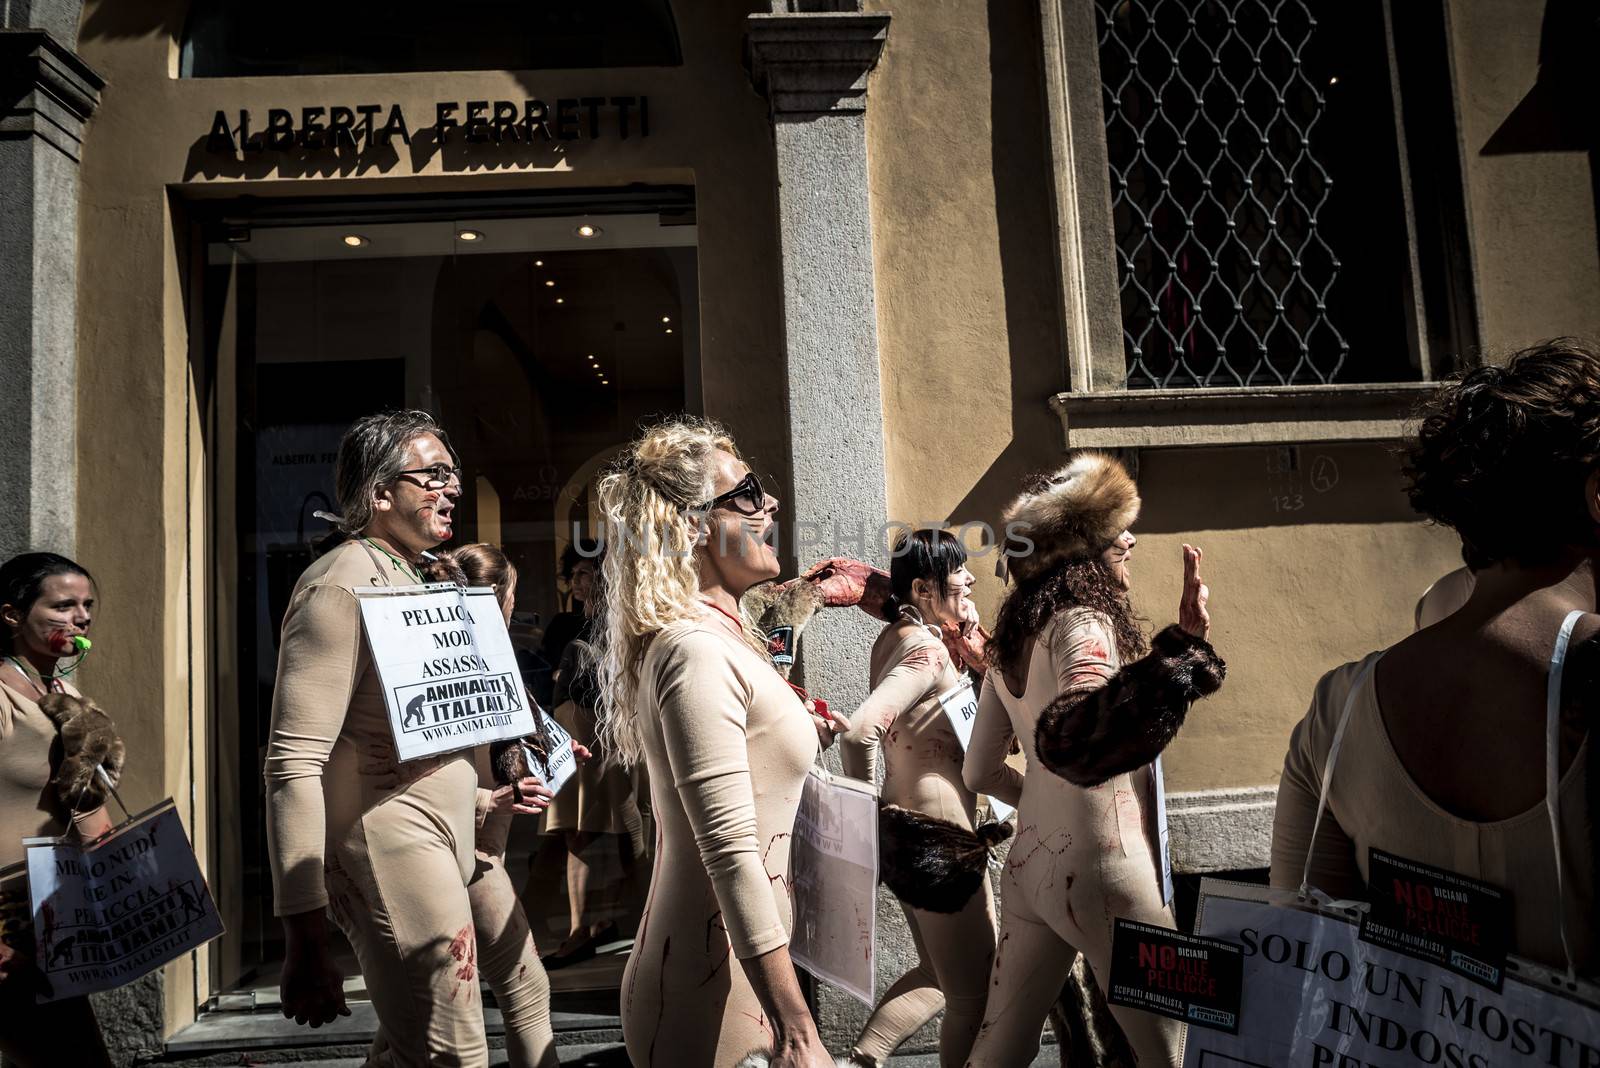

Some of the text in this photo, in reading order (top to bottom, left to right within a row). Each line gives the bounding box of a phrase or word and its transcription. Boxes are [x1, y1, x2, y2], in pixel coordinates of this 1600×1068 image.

[206, 96, 649, 154] ALBERTA FERRETTI
[272, 454, 316, 465] ALBERTA
[432, 630, 474, 649] MOD
[109, 831, 158, 869] NUDI
[111, 871, 136, 893] IN
[1391, 878, 1469, 913] NO DICIAMO
[1365, 921, 1398, 941] SCOPRITI
[1137, 941, 1209, 972] NO DICIAMO
[1178, 958, 1209, 977] ALLE
[1239, 928, 1351, 982] SOLO
[1363, 961, 1427, 1009] UN
[1114, 984, 1143, 999] SCOPRITI
[1147, 969, 1218, 997] PELLICCE
